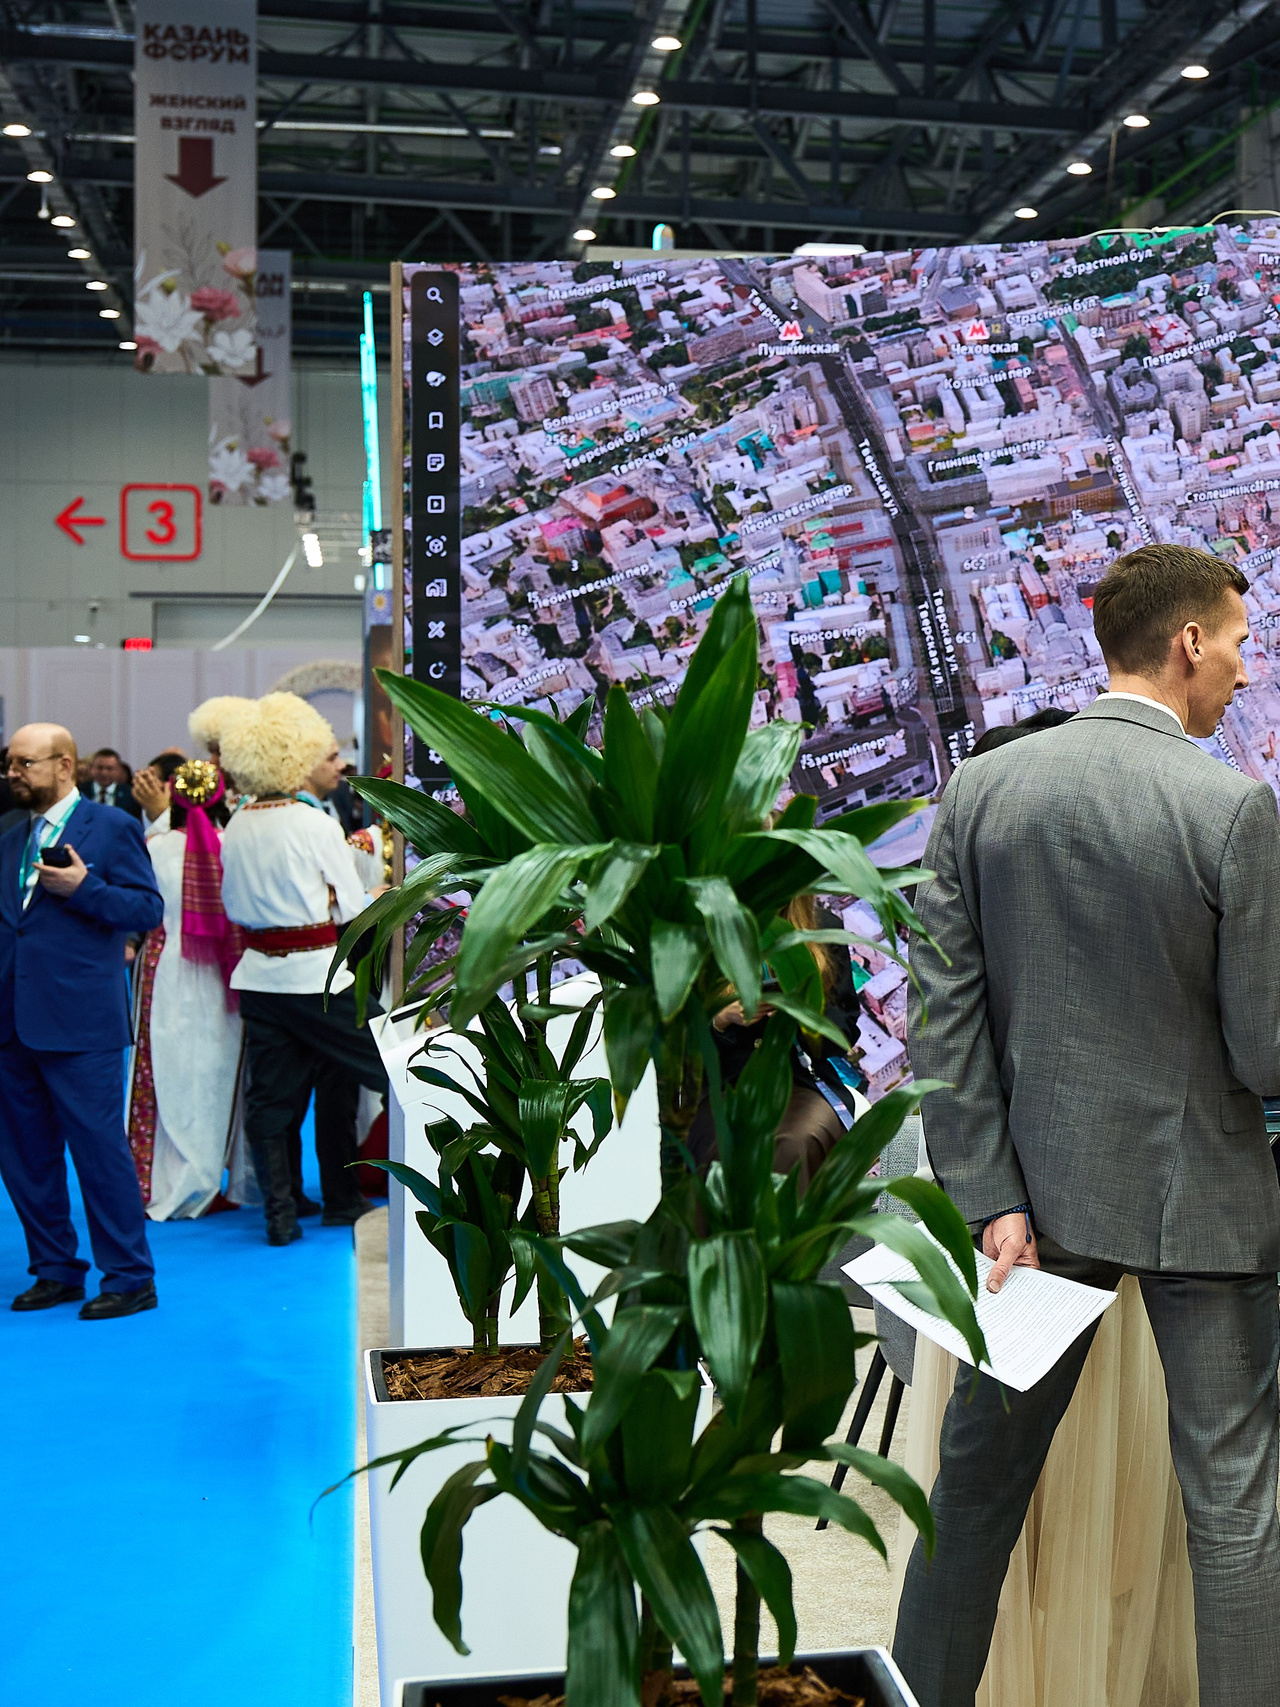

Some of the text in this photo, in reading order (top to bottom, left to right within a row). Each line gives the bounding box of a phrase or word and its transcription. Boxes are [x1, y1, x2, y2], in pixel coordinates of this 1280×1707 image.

[144, 23, 250, 45] КАЗАНЬ
[144, 43, 250, 64] ФОРУМ
[1062, 253, 1128, 277] Страстной
[1197, 284, 1210, 296] 27
[1006, 303, 1072, 326] Страстной
[758, 343, 840, 358] Пушкинская
[951, 343, 1019, 355] Чеховская
[542, 405, 601, 431] Большая
[858, 438, 891, 501] Тверская
[146, 500, 177, 545] 3
[670, 566, 757, 613] Вознесенсй
[917, 601, 939, 666] Тверская
[932, 588, 955, 657] Тверская
[790, 627, 840, 648] Брюсов
